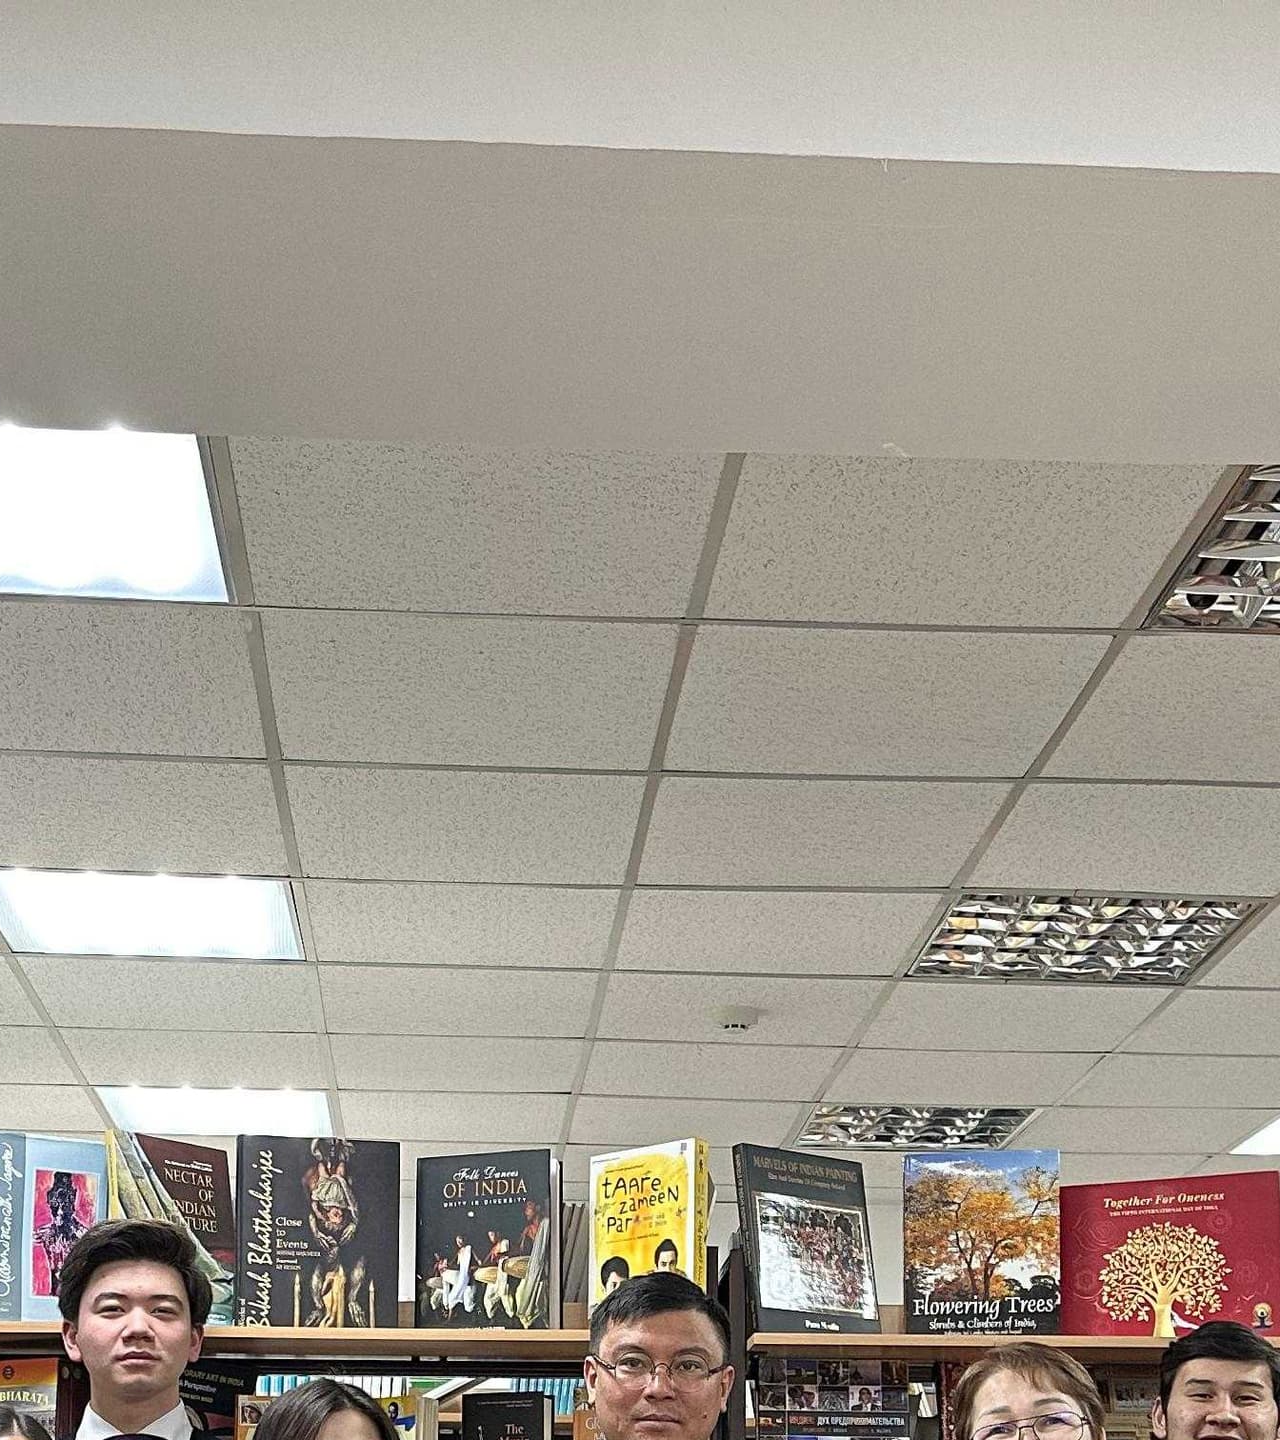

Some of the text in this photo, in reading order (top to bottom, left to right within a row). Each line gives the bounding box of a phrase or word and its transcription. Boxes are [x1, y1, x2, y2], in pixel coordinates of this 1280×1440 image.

[164, 1167, 214, 1188] NECTAR
[452, 1166, 520, 1183] Folk Dances
[752, 1154, 787, 1172] MARVELS
[786, 1161, 799, 1174] OF
[799, 1163, 825, 1178] INDIAN
[825, 1168, 858, 1184] PAINTING
[198, 1189, 215, 1202] OF
[443, 1178, 528, 1199] OF INDIA
[175, 1199, 217, 1218] NDIAN
[1102, 1191, 1225, 1210] Together For Oneness
[275, 1216, 303, 1227] Close
[246, 1150, 283, 1327] Bikash Bhattacharjee
[275, 1228, 287, 1237] to
[275, 1239, 309, 1250] Events
[912, 1291, 1055, 1321] Flowering Trees
[928, 1318, 956, 1330] Shrubs
[957, 1321, 966, 1329] &
[966, 1317, 1003, 1329] Climbers
[1004, 1315, 1014, 1330] of
[505, 1424, 524, 1435] The
